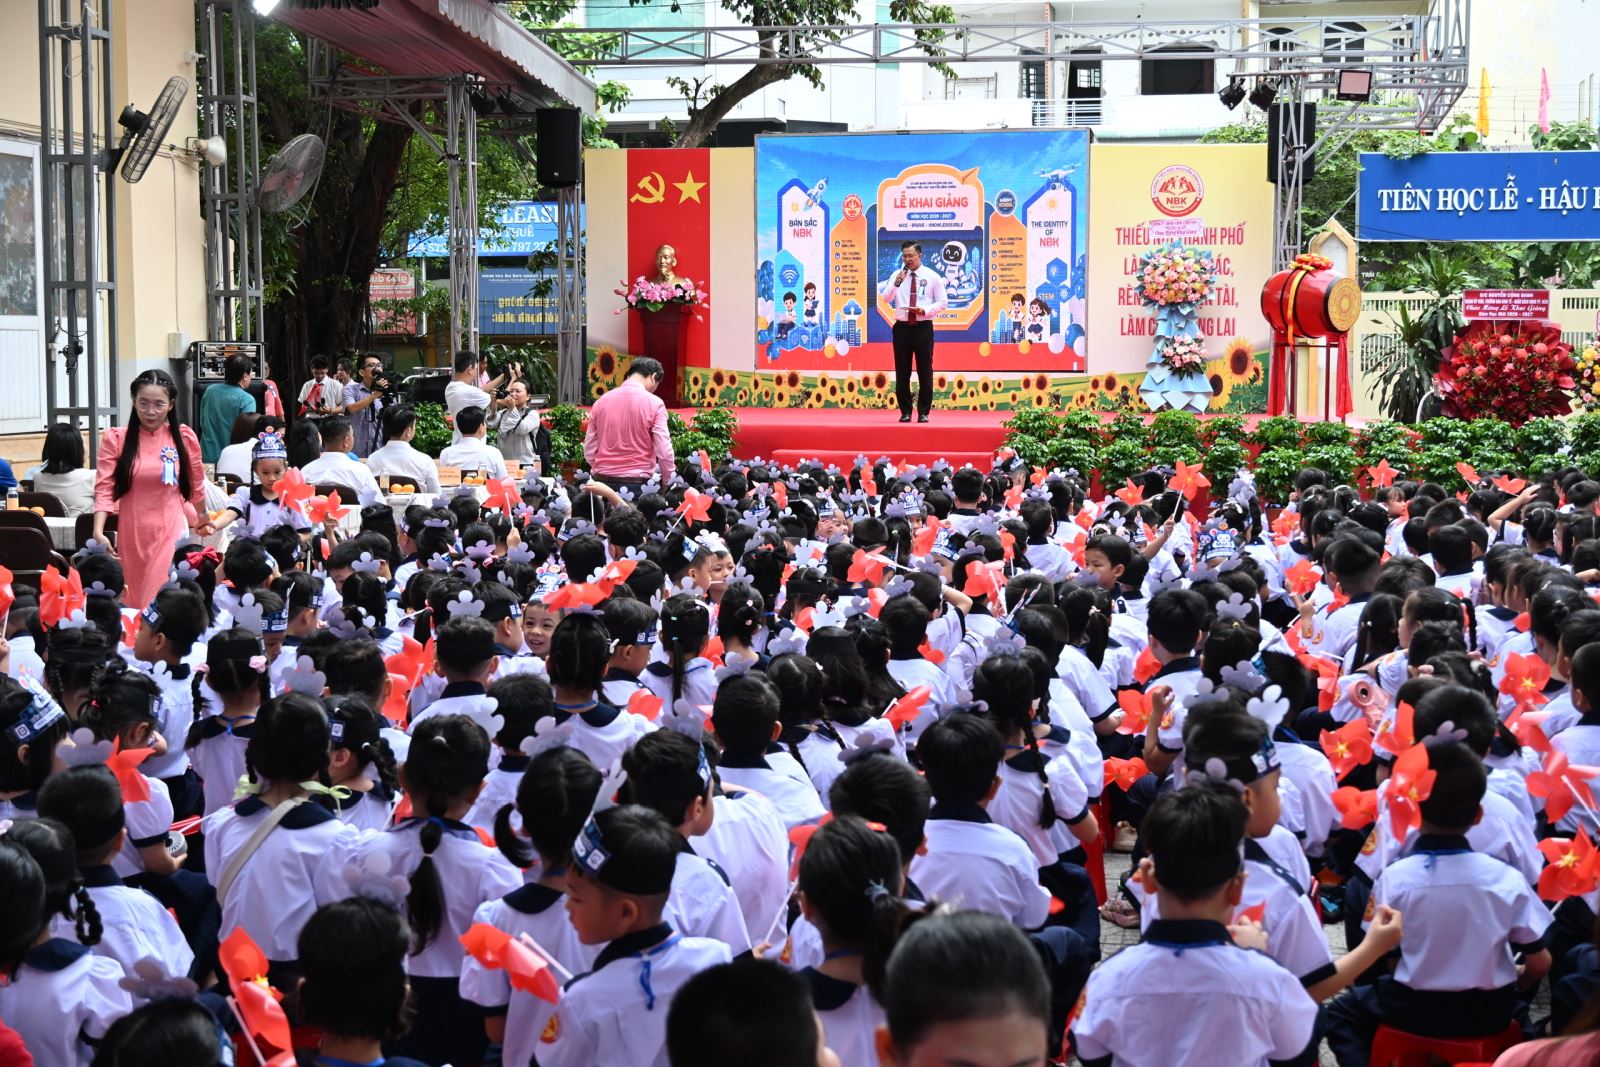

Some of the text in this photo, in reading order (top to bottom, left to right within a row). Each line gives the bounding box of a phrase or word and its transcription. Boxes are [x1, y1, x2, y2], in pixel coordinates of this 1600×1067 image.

[894, 191, 968, 208] LỄ KHAI GIẢNG
[1378, 182, 1430, 211] TIÊN
[1436, 188, 1484, 216] HỌC
[1488, 172, 1518, 210] LỄ
[1539, 180, 1588, 216] HẬU
[793, 228, 812, 238] NBK
[1040, 238, 1059, 247] NBK
[1116, 222, 1150, 245] THIẾU
[1220, 220, 1247, 245] PHỐ
[1124, 254, 1143, 276] LÀ
[1216, 284, 1239, 308] TÀI,
[1121, 314, 1145, 336] LÀM
[1217, 318, 1236, 336] LAI
